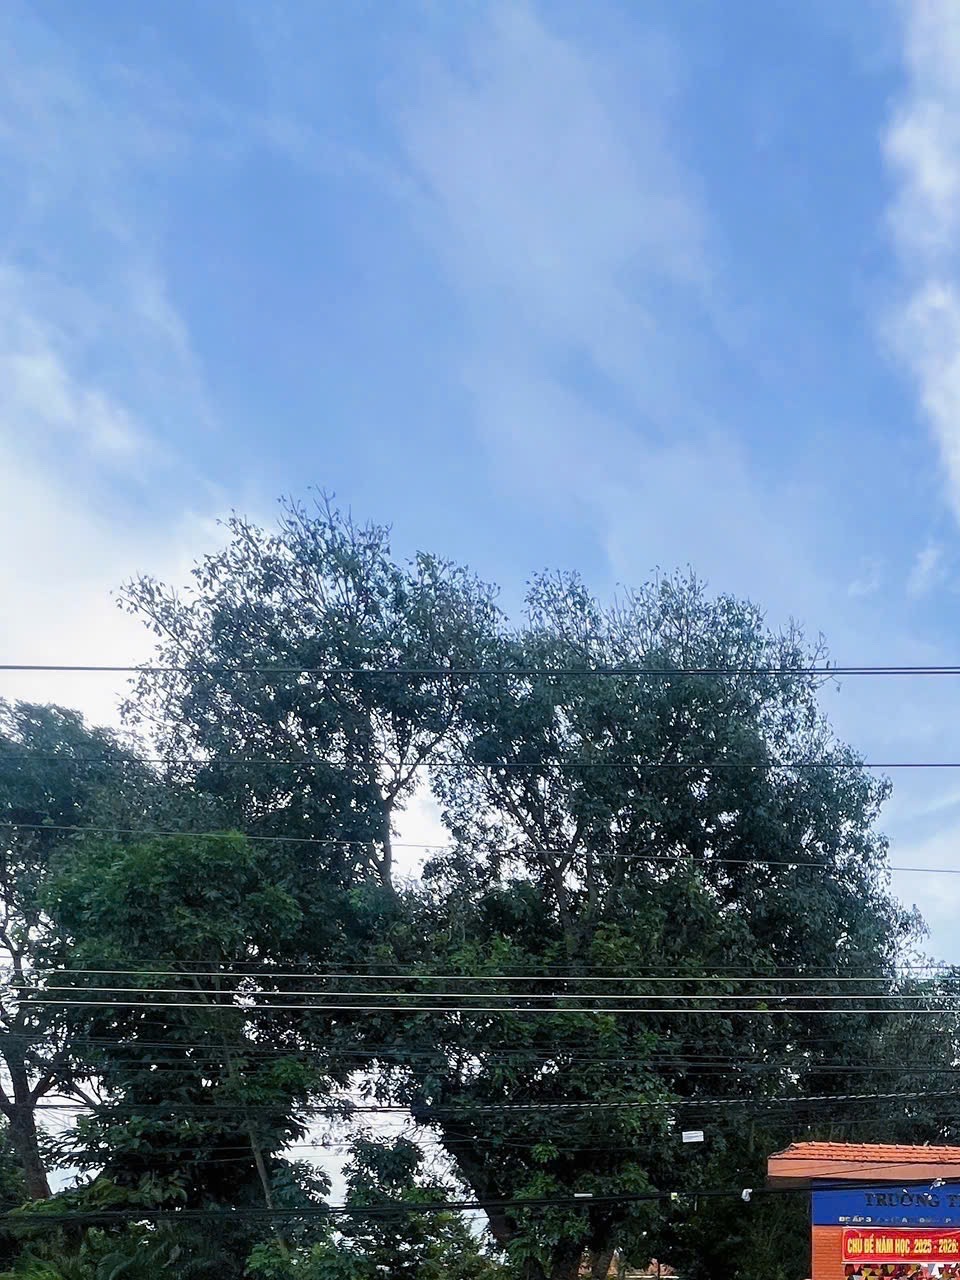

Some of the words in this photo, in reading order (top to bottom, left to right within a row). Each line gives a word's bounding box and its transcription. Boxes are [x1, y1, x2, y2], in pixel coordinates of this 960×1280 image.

[876, 1235, 894, 1254] NĂM
[895, 1238, 911, 1257] HỌC
[913, 1238, 932, 1254] 2025
